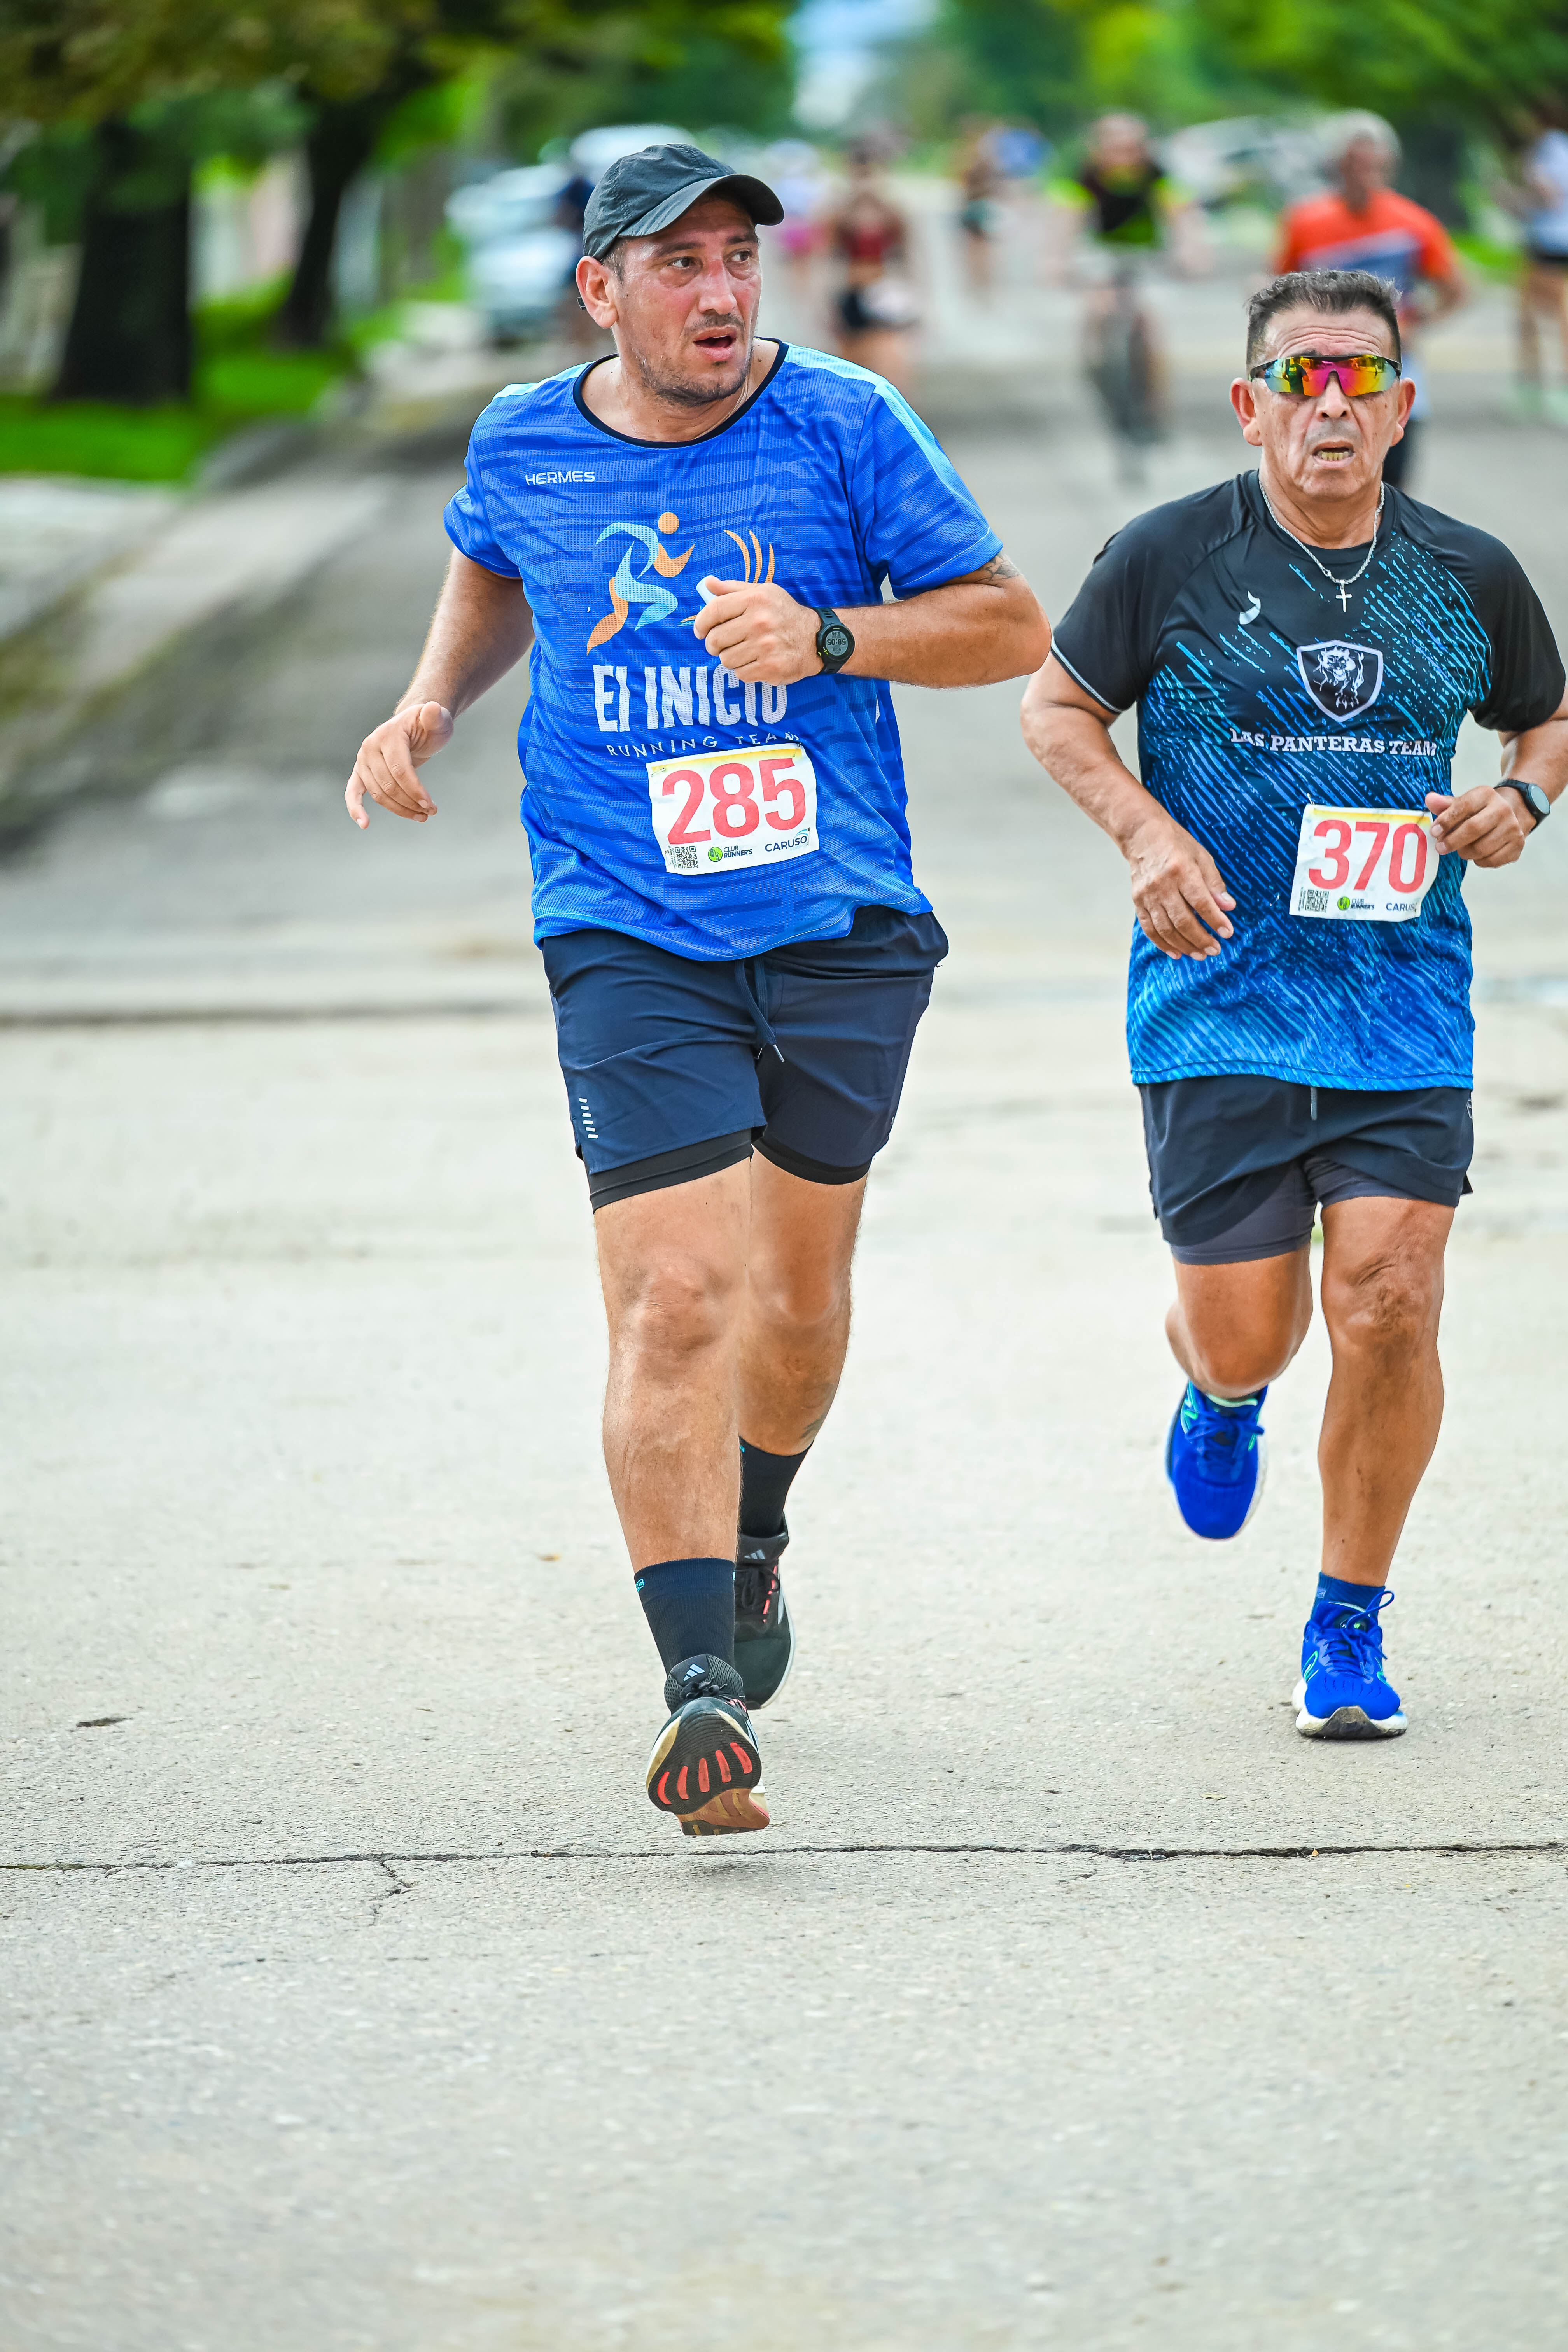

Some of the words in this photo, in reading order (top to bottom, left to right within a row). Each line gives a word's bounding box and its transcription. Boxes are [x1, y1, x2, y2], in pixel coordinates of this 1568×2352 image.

[525, 471, 595, 486] HERMES
[606, 736, 717, 758] RUNNING
[1229, 728, 1265, 747] LAS
[1270, 735, 1385, 754] PANTERAS
[1389, 740, 1437, 756] TEAM
[662, 758, 806, 845] 285
[724, 849, 752, 858] RUNNER'S
[765, 835, 807, 852] CARUSO
[1308, 819, 1427, 894] 370
